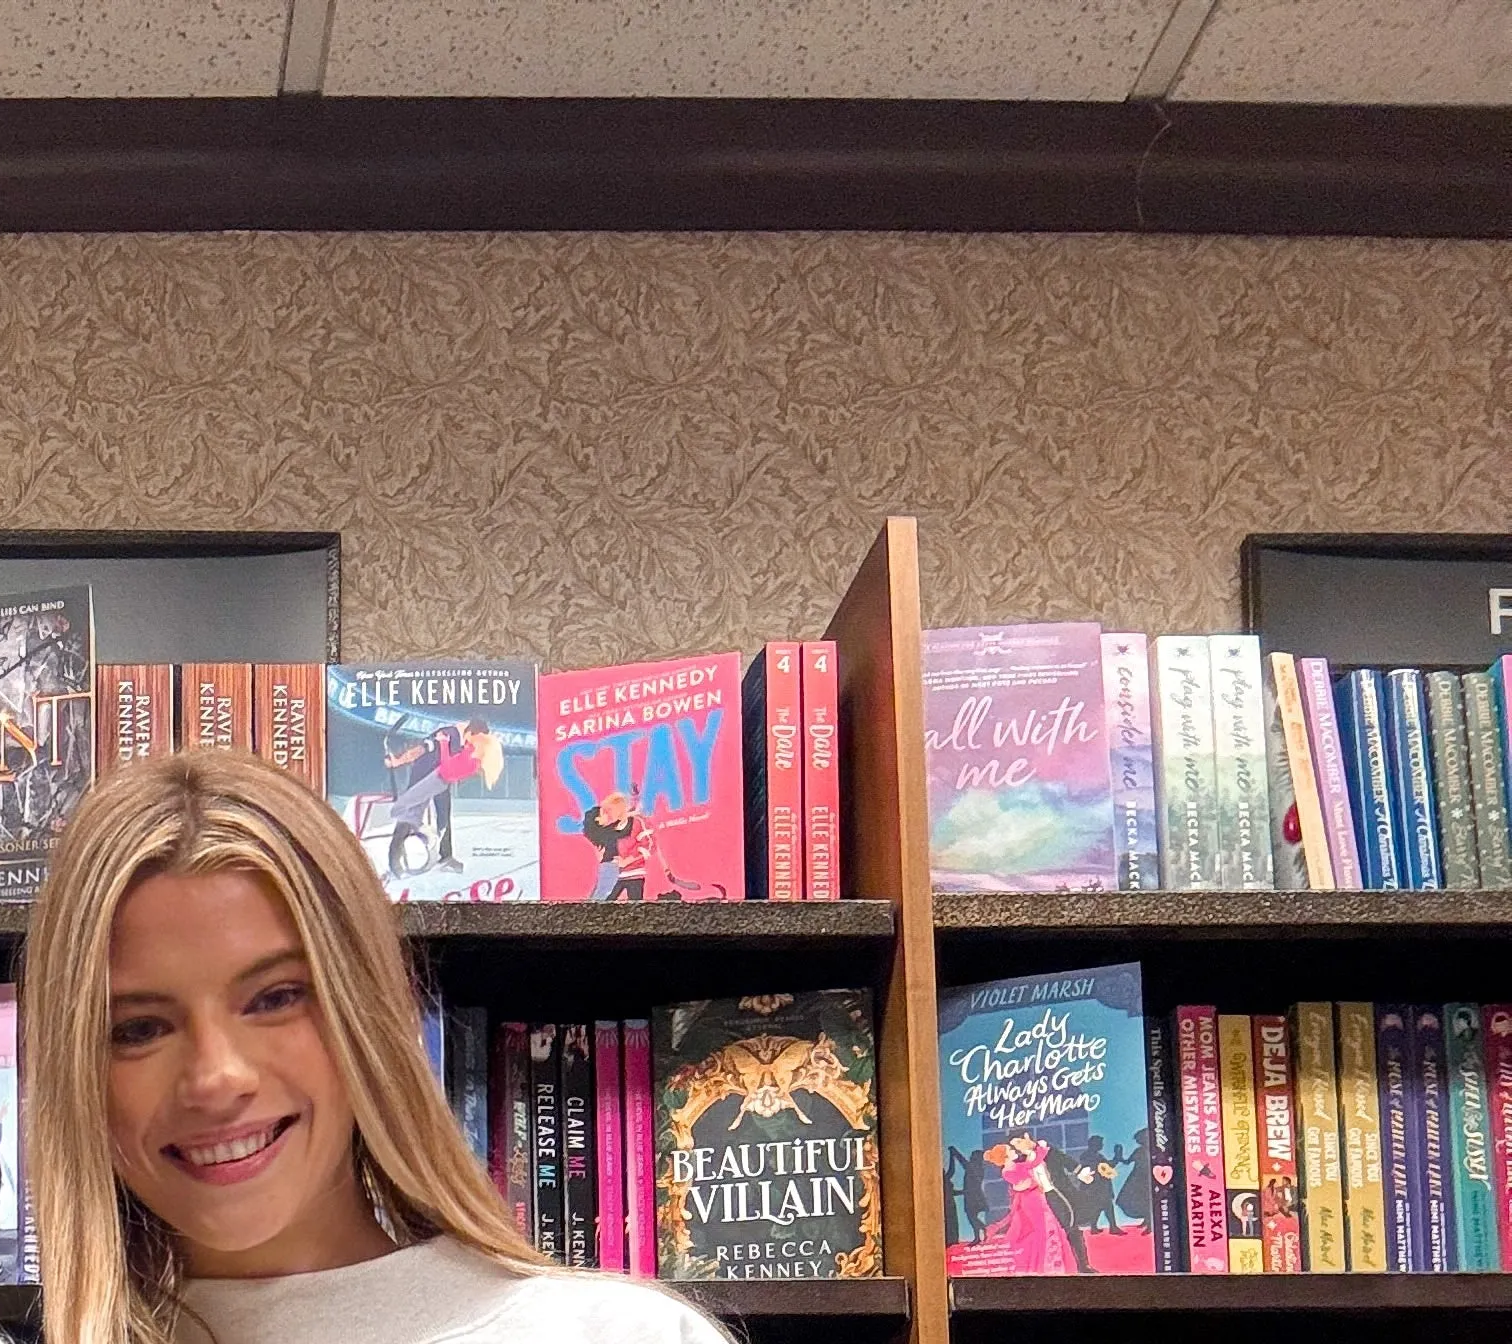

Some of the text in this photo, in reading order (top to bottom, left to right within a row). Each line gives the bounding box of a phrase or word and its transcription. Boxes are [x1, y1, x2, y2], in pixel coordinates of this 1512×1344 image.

[344, 677, 522, 708] ELLE KENNEDY
[554, 689, 723, 742] SARINA BOWEN
[558, 664, 720, 716] ELLE KENNEDY
[995, 695, 1100, 746] with
[555, 709, 724, 835] STAY
[955, 756, 1036, 791] me
[969, 977, 1096, 1010] VIOLET MARSH
[994, 1008, 1071, 1053] Lady
[950, 1033, 1107, 1085] Charlotte
[964, 1060, 1106, 1117] Always Gets
[988, 1091, 1100, 1128] Her Man
[1261, 1025, 1292, 1162] DEJA BREW
[687, 1175, 856, 1226] VILLAIN
[716, 1240, 833, 1262] REBECCA
[726, 1260, 822, 1279] KENNEY
